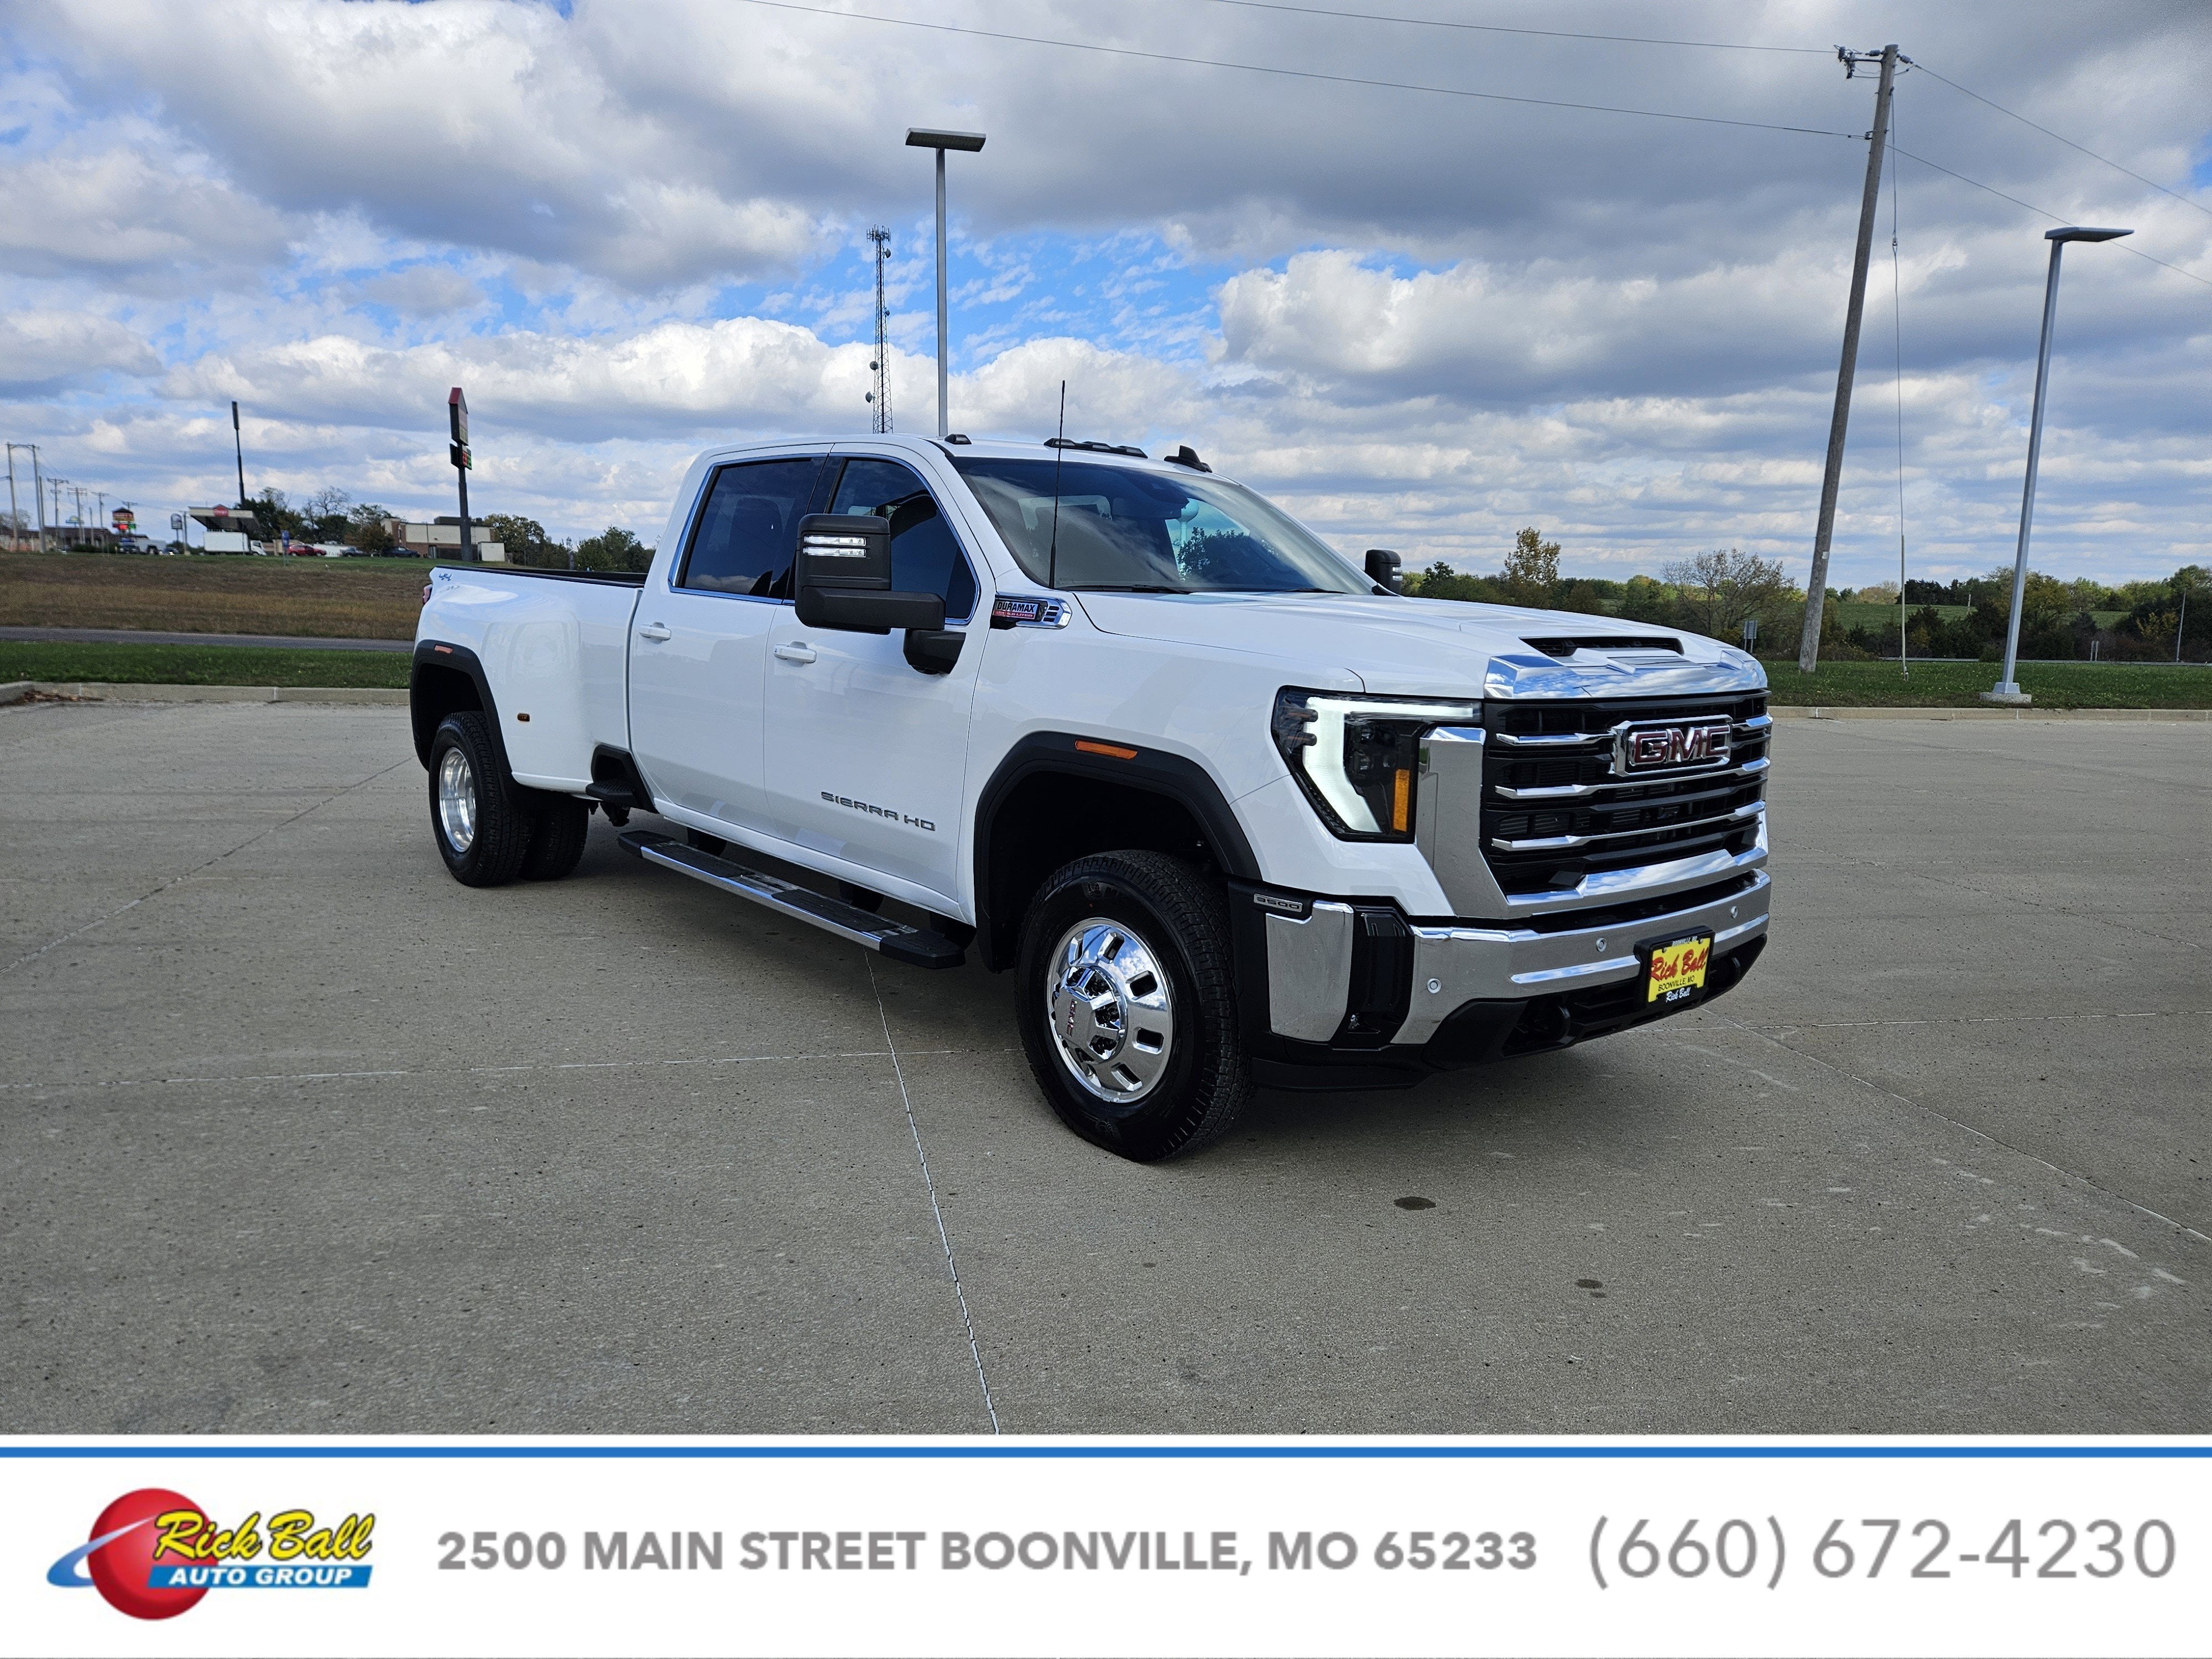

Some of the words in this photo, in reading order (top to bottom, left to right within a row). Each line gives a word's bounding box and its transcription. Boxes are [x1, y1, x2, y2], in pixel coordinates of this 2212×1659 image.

[997, 602, 1036, 613] DURAMAX
[1629, 724, 1731, 766] GMC
[821, 791, 899, 821] SIERRA
[904, 814, 936, 831] HD
[1256, 896, 1300, 910] 3500
[1651, 953, 1680, 982] Rick
[1681, 946, 1709, 975] Ball
[1688, 975, 1695, 984] MO
[1666, 989, 1679, 1003] Rick
[1679, 987, 1691, 999] Ball
